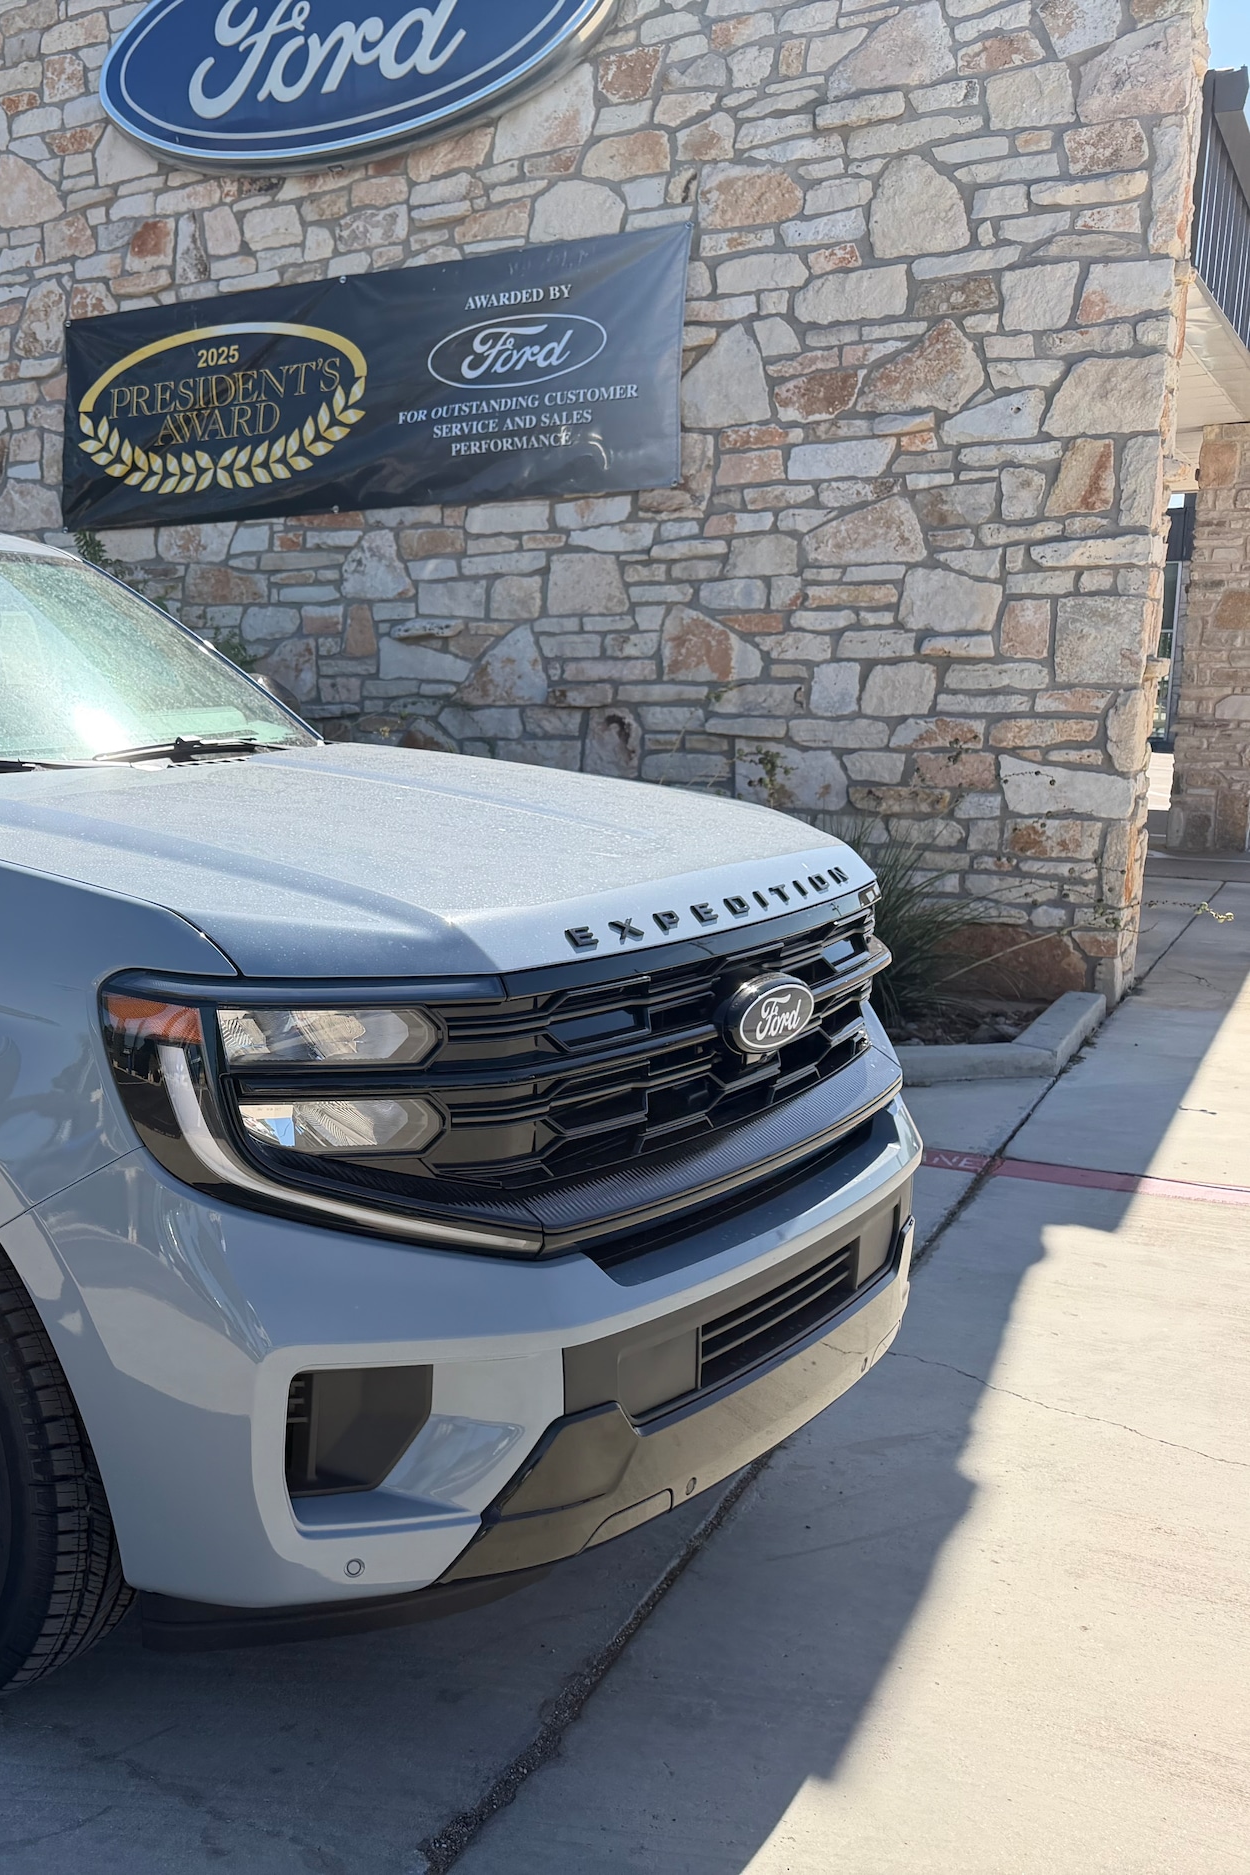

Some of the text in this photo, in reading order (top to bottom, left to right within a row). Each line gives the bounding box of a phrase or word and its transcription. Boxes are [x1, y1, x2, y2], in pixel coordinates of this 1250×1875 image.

[188, 0, 467, 119] Ford
[464, 284, 572, 310] AWARDED BY
[197, 345, 240, 368] 2025
[461, 324, 573, 379] Ford
[109, 358, 340, 420] PRESIDENT'S
[398, 384, 639, 425] FOR OUTSTANDING CUSTOMER
[154, 402, 281, 446] AWARD
[433, 409, 592, 438] SERVICE AND SALES
[451, 431, 572, 456] PERFORMANCE
[564, 866, 850, 950] EXPEDITION
[755, 993, 802, 1040] Ford
